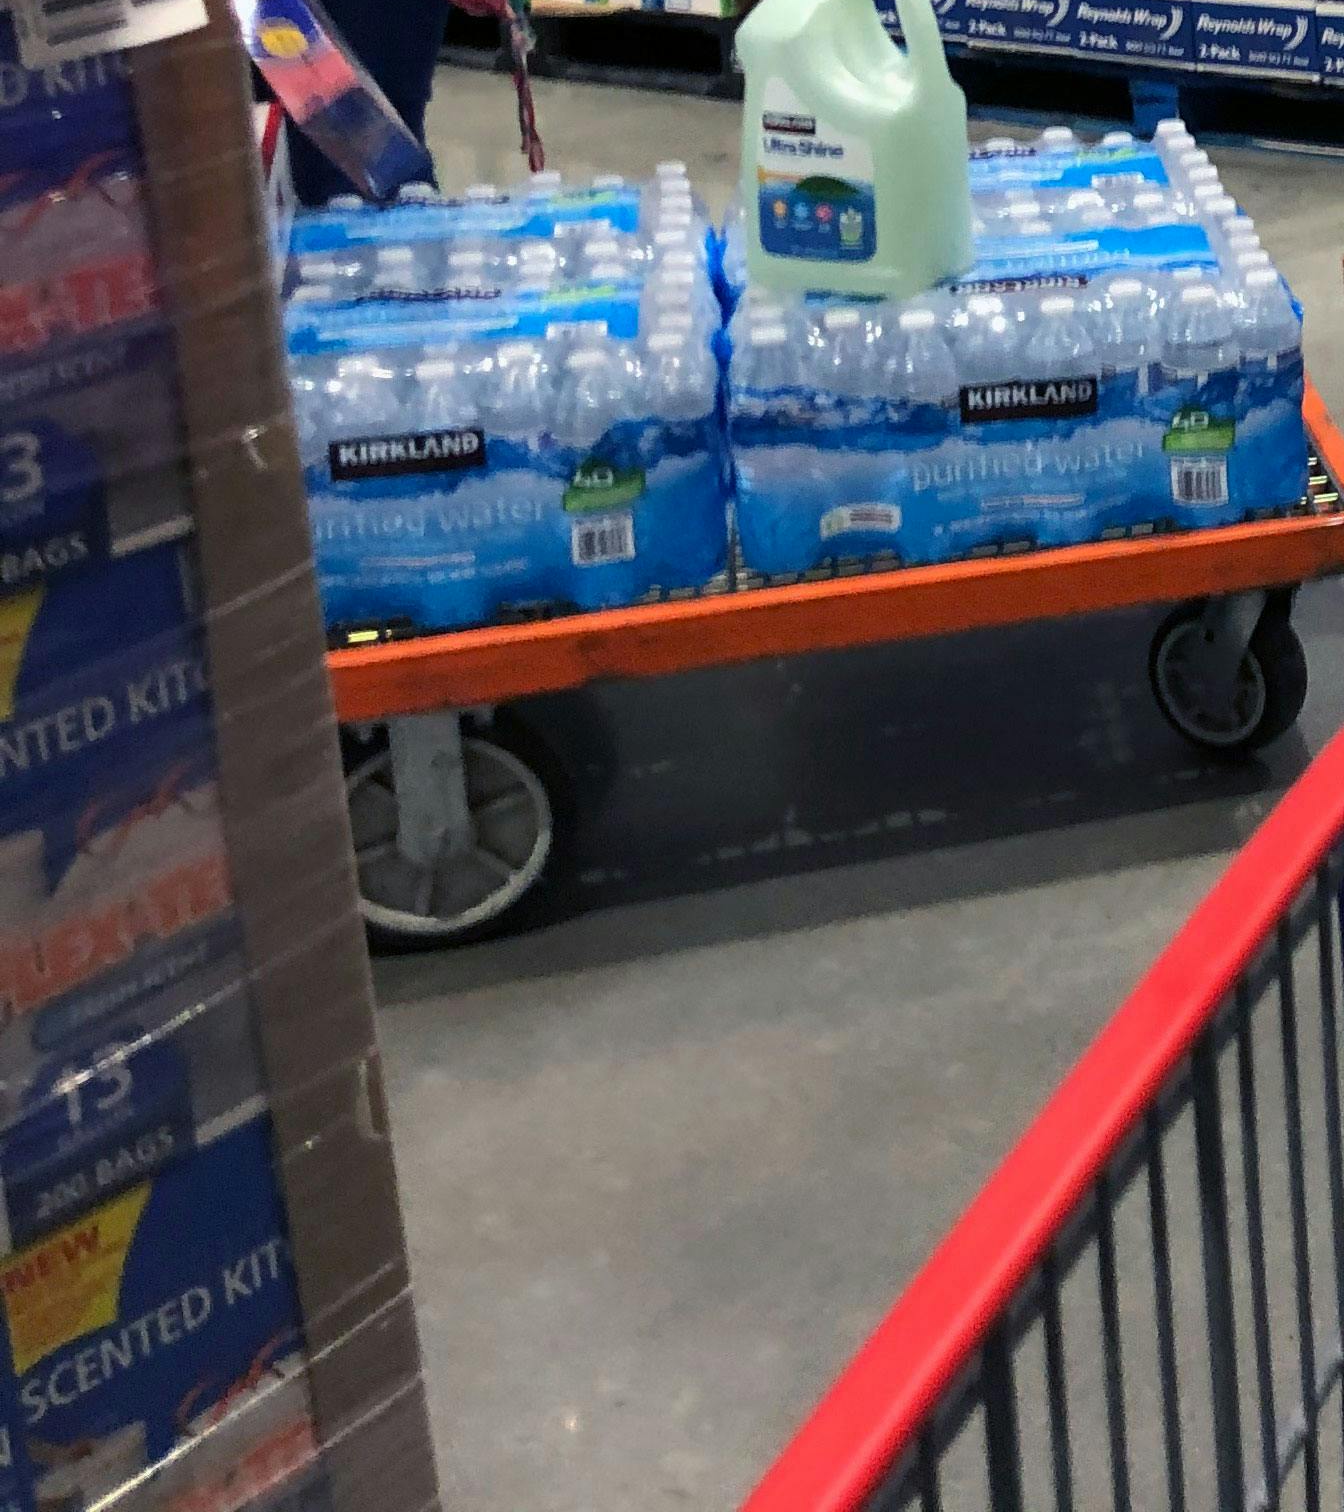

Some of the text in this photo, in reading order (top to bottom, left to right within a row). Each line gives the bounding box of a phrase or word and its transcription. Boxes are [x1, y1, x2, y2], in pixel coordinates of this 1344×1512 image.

[1197, 13, 1291, 39] Reynolds Wrap
[967, 383, 1093, 411] KIRKLAND
[339, 432, 479, 466] KIRKLAND
[21, 1286, 213, 1424] SCENTED
